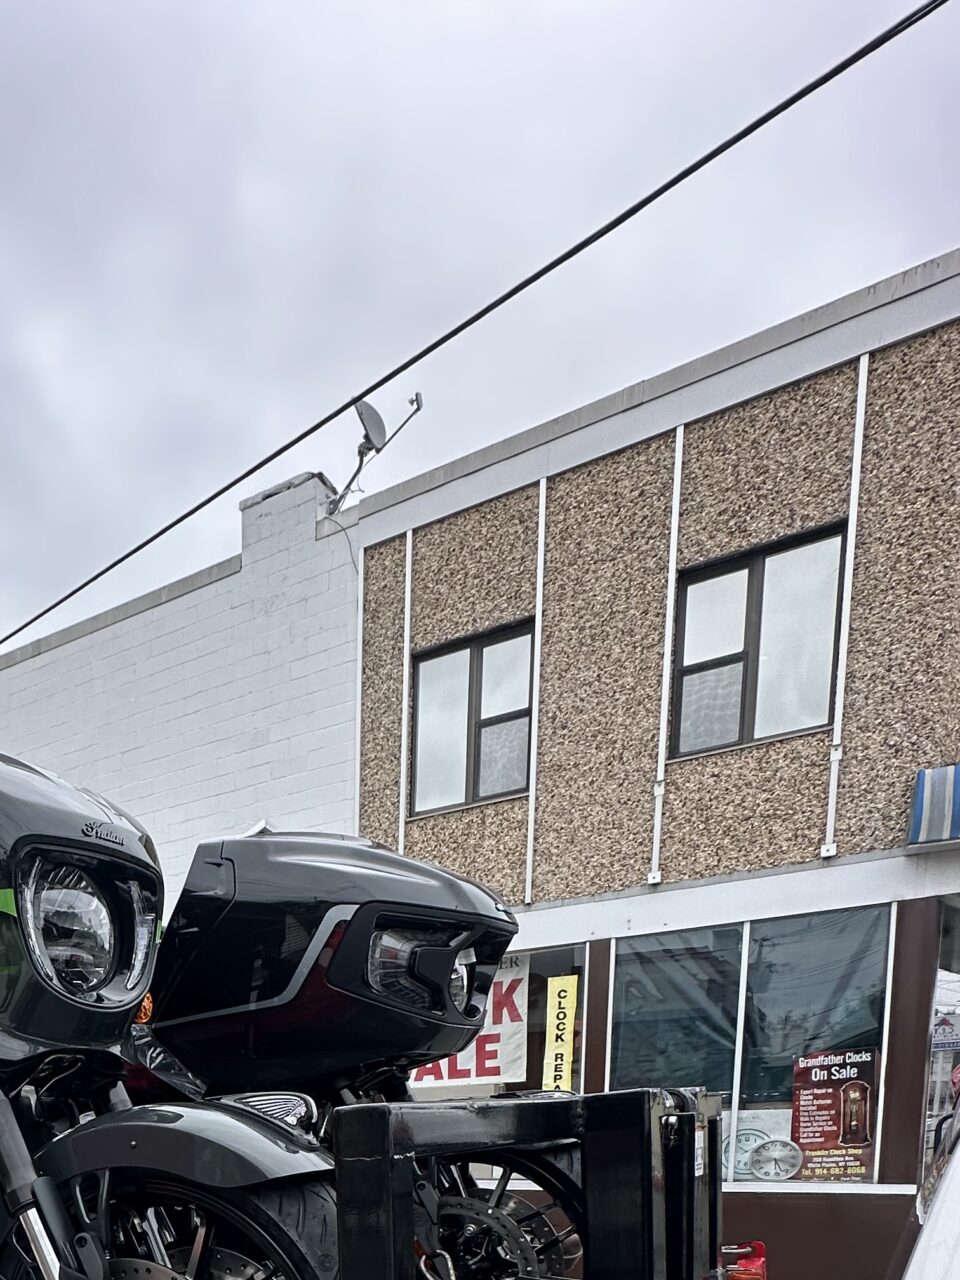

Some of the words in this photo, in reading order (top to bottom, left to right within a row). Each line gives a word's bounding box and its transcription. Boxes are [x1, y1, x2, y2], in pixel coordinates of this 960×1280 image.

[554, 989, 568, 1043] CLOCK
[409, 1033, 501, 1082] ALE
[799, 1054, 844, 1068] Grandfather
[845, 1051, 872, 1063] Clocks
[811, 1068, 828, 1081] On
[830, 1065, 858, 1080] Sale
